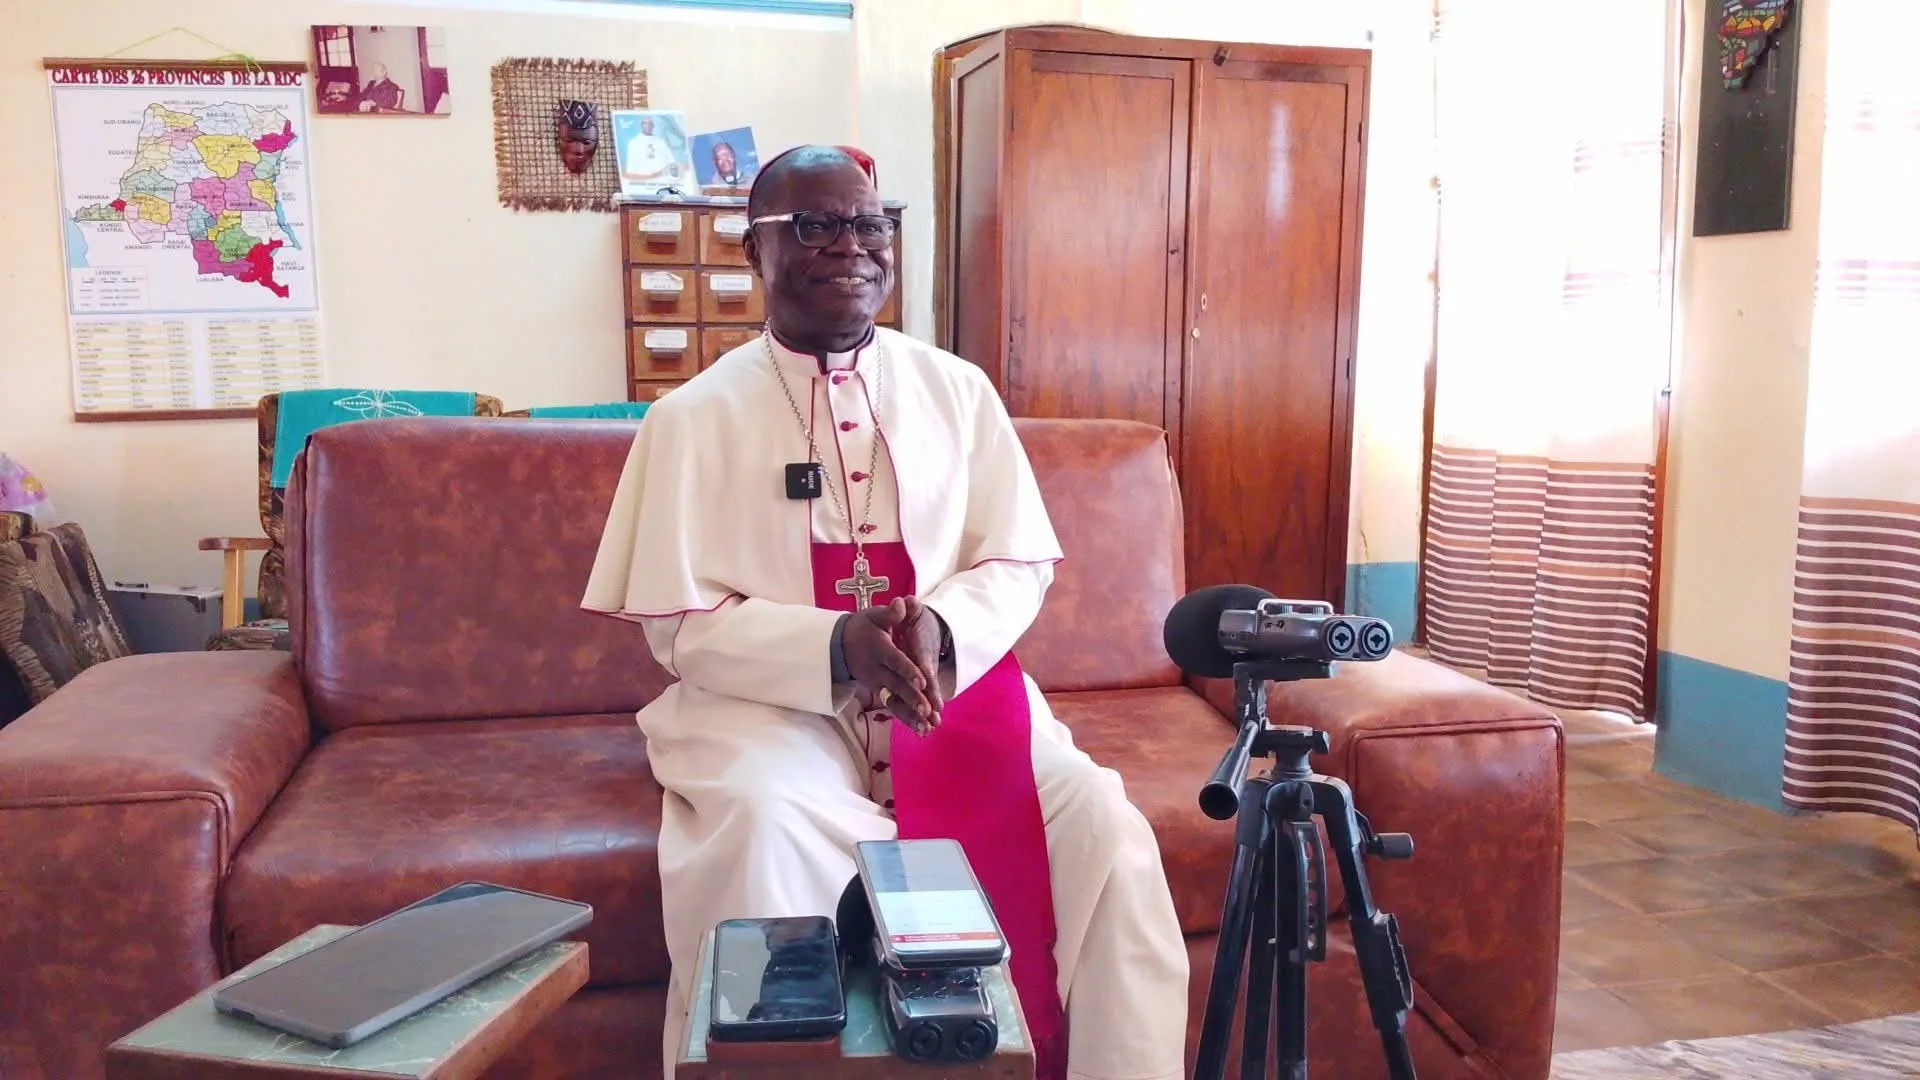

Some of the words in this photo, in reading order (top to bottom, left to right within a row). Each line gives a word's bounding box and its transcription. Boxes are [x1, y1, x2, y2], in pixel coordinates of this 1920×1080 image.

[52, 68, 99, 84] CARTE
[102, 69, 129, 85] DES
[147, 69, 225, 86] PROVINCES
[231, 71, 251, 86] DE
[253, 71, 271, 86] LA
[274, 71, 302, 87] RDC
